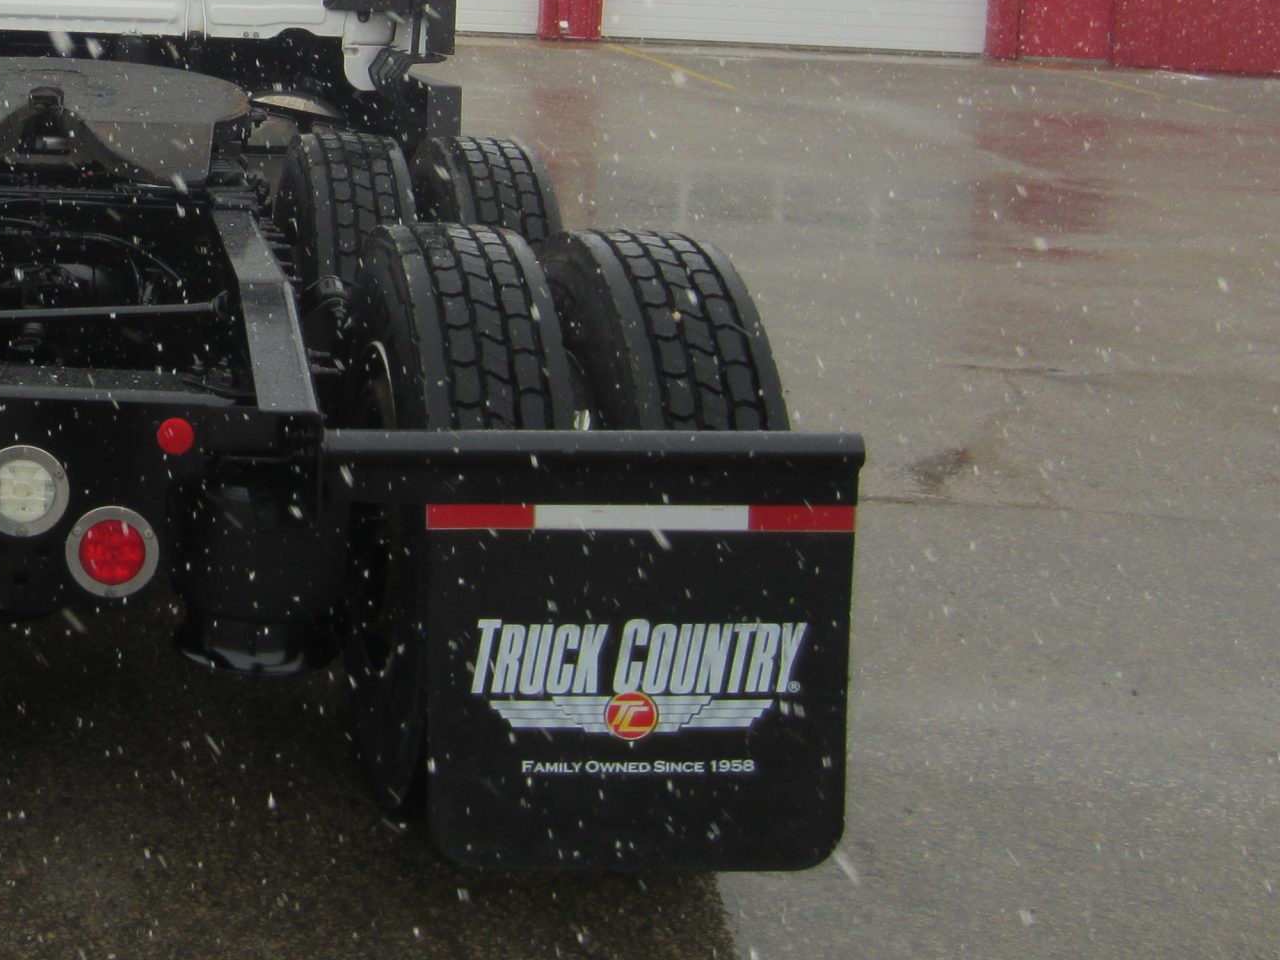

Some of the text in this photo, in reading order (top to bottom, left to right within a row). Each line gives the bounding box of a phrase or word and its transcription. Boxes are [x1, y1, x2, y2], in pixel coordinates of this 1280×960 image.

[471, 618, 610, 695] TRUCK
[521, 759, 755, 773] FAMILY OWNED SINCE 1958
